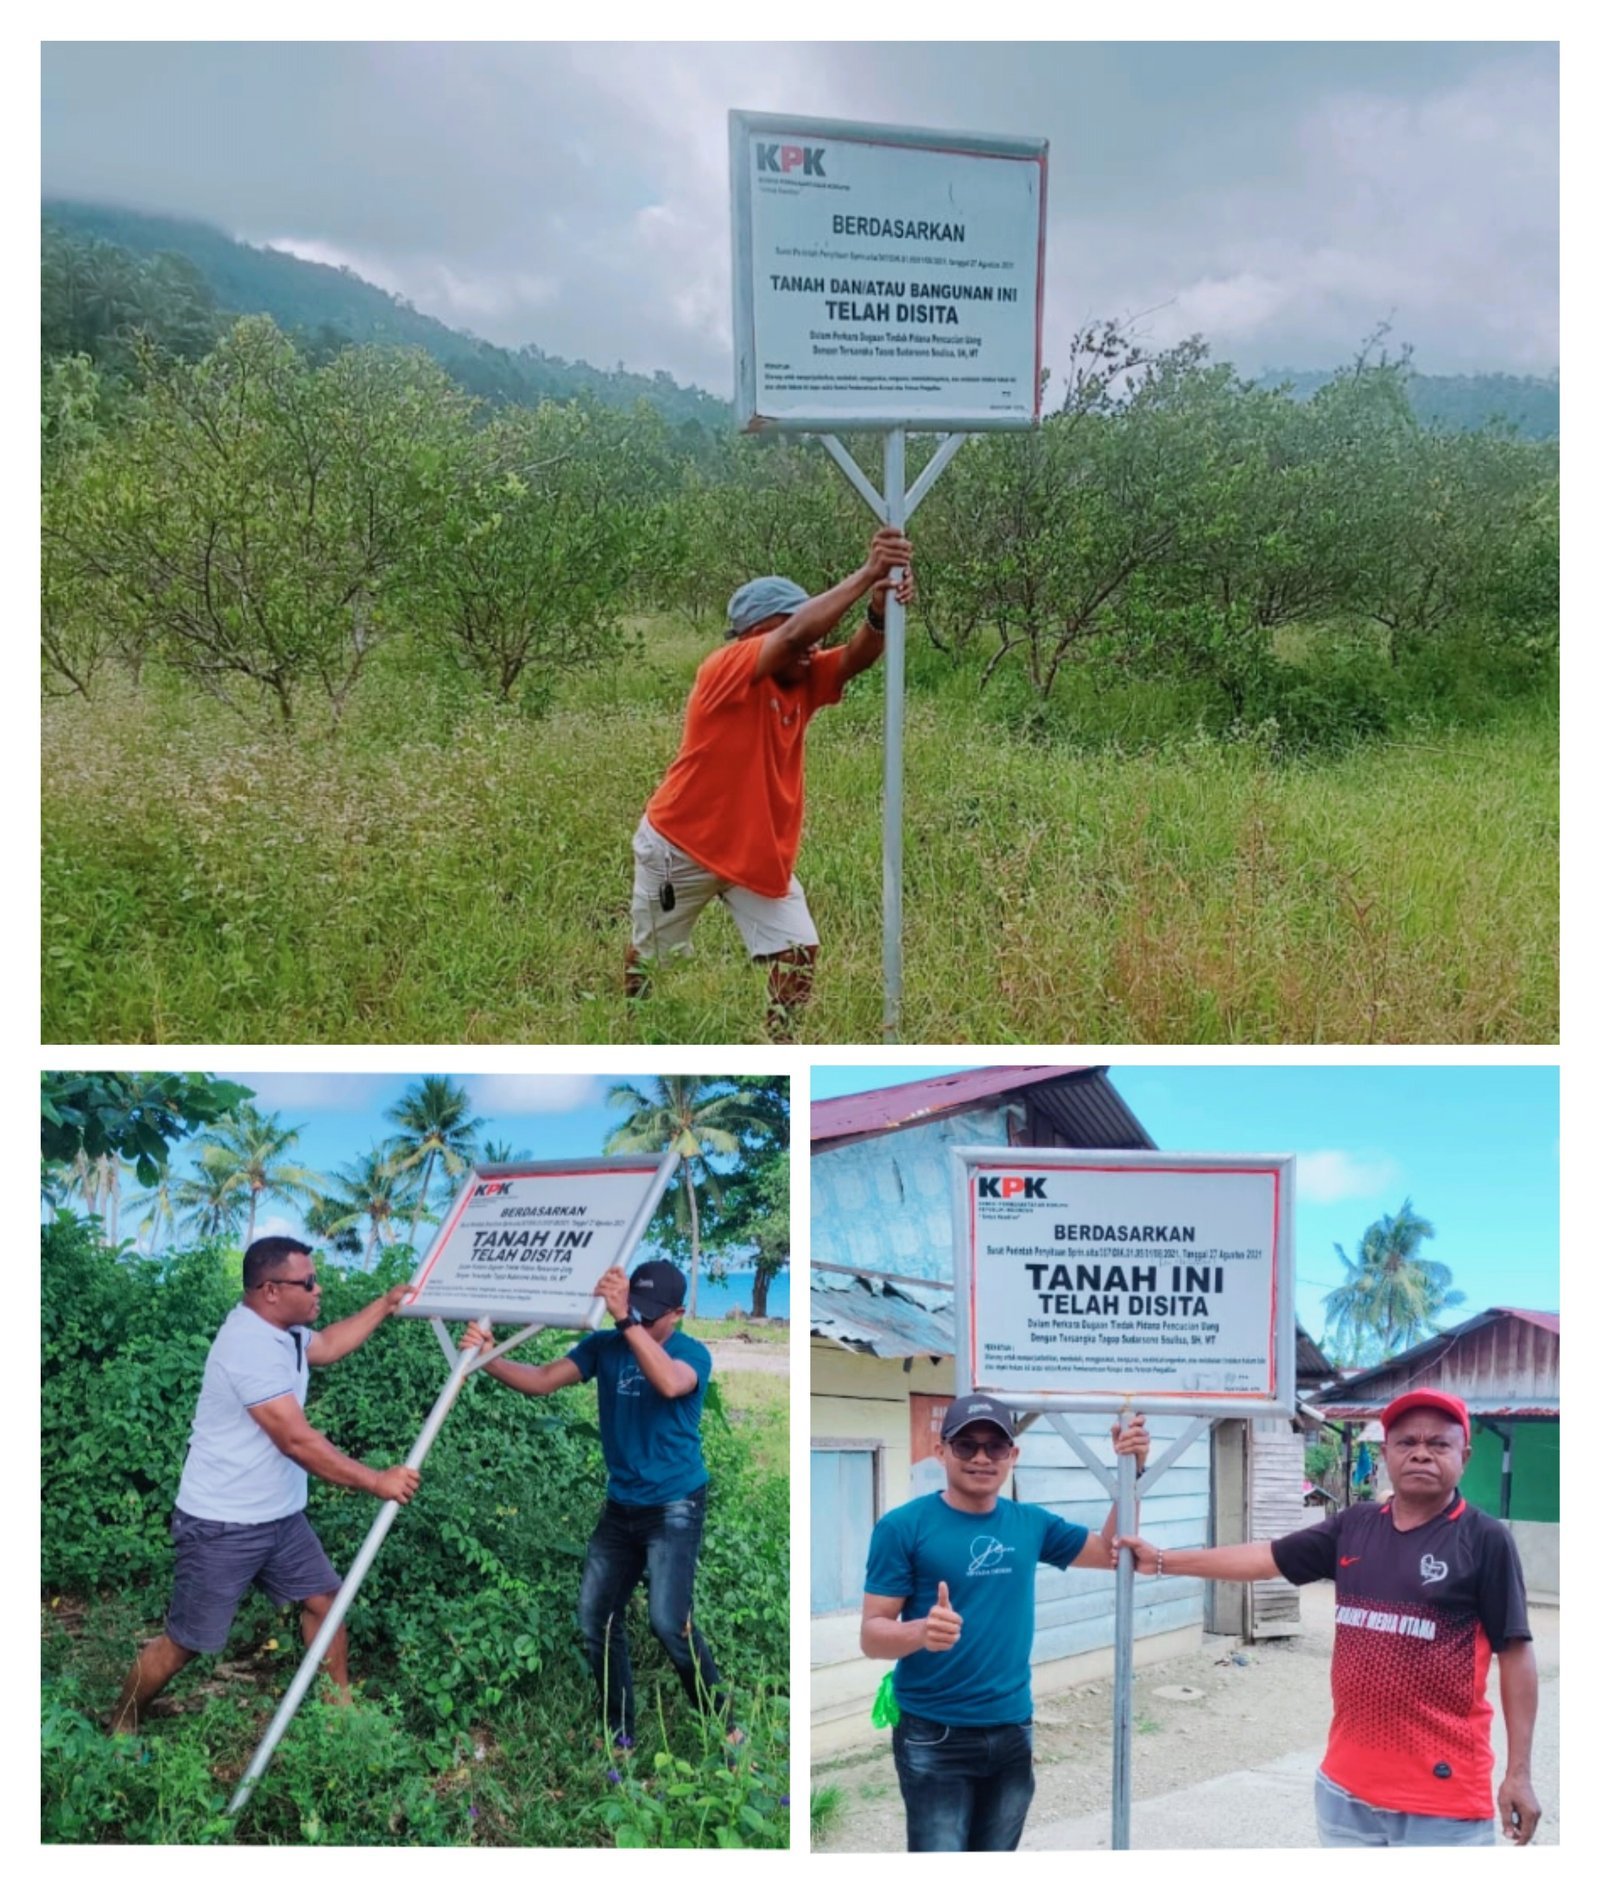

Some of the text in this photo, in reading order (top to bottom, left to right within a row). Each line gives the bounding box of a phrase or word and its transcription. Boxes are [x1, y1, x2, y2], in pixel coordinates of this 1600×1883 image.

[757, 143, 826, 176] KPK
[833, 214, 965, 242] BERDASARKAN
[770, 275, 1018, 303] TANAH DAN/ATAU BANGUNAN INI
[825, 300, 959, 325] TELAH DISITA
[474, 1181, 514, 1197] KPK
[979, 1177, 1047, 1199] KPK
[501, 1205, 588, 1218] BERDASARKAN
[471, 1230, 594, 1248] TANAH INI
[1054, 1224, 1195, 1242] BERDASARKAN
[470, 1248, 573, 1263] TELAH DISITA
[1025, 1263, 1224, 1294] TANAH INI
[1038, 1294, 1209, 1317] TELAH DISITA
[1028, 1318, 1219, 1333] Dalam Perkara Dugaan Tindak Pidana Pencucian Uang
[1031, 1332, 1057, 1344] Dengan
[1059, 1333, 1096, 1346] Tersangka
